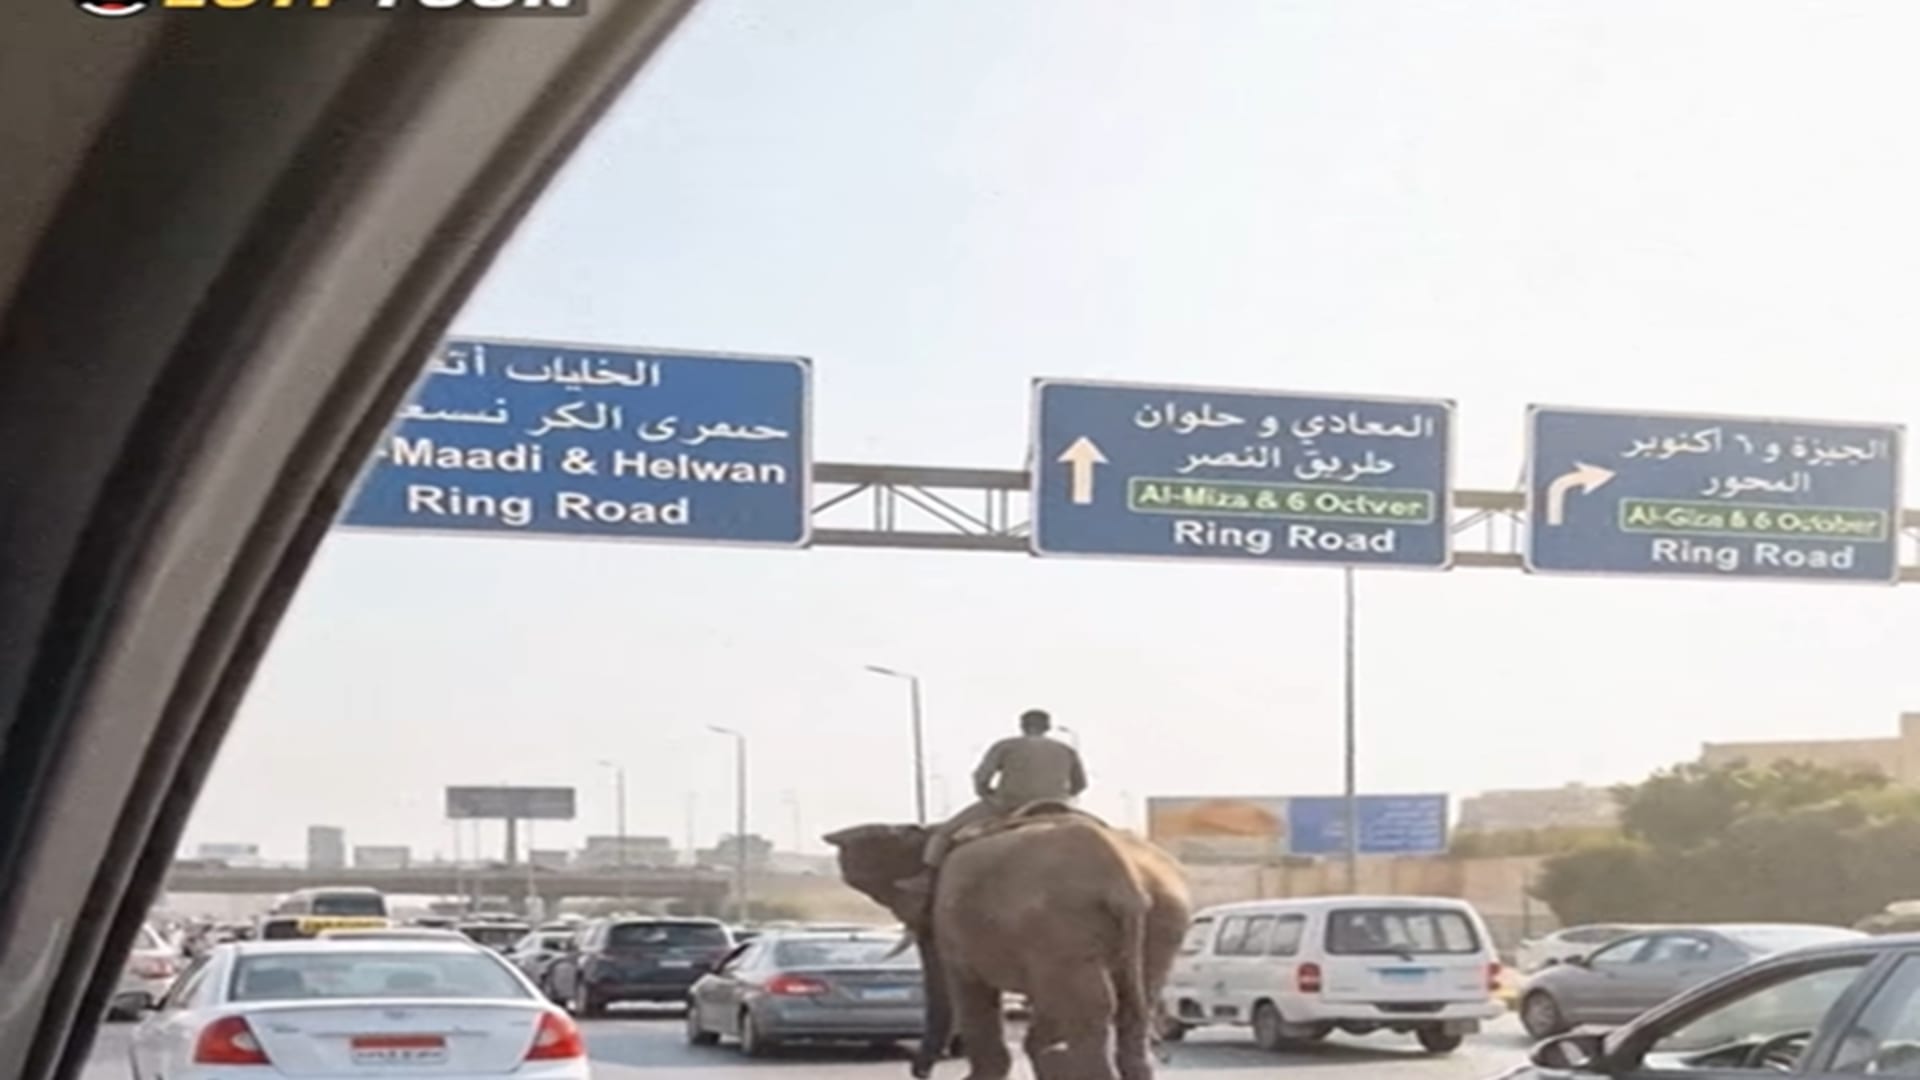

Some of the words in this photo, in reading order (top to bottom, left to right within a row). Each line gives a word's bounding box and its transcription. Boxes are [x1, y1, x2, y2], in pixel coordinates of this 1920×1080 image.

[1134, 402, 1245, 434] حلوان
[1258, 415, 1280, 438] و
[1291, 411, 1433, 445] المعادي
[561, 446, 598, 476] &
[613, 450, 787, 485] Helwan
[1790, 435, 1889, 465] الجيزة
[1255, 489, 1278, 511] &
[1286, 490, 1307, 512] 6
[1700, 471, 1810, 499] المحور
[407, 485, 532, 526] Ring
[557, 491, 690, 525] Road
[1728, 509, 1748, 529] &
[1753, 510, 1773, 530] 6
[1174, 520, 1272, 555] Ring
[1288, 524, 1396, 553] Road
[1651, 539, 1740, 571] Ring
[1754, 542, 1855, 569] Road
